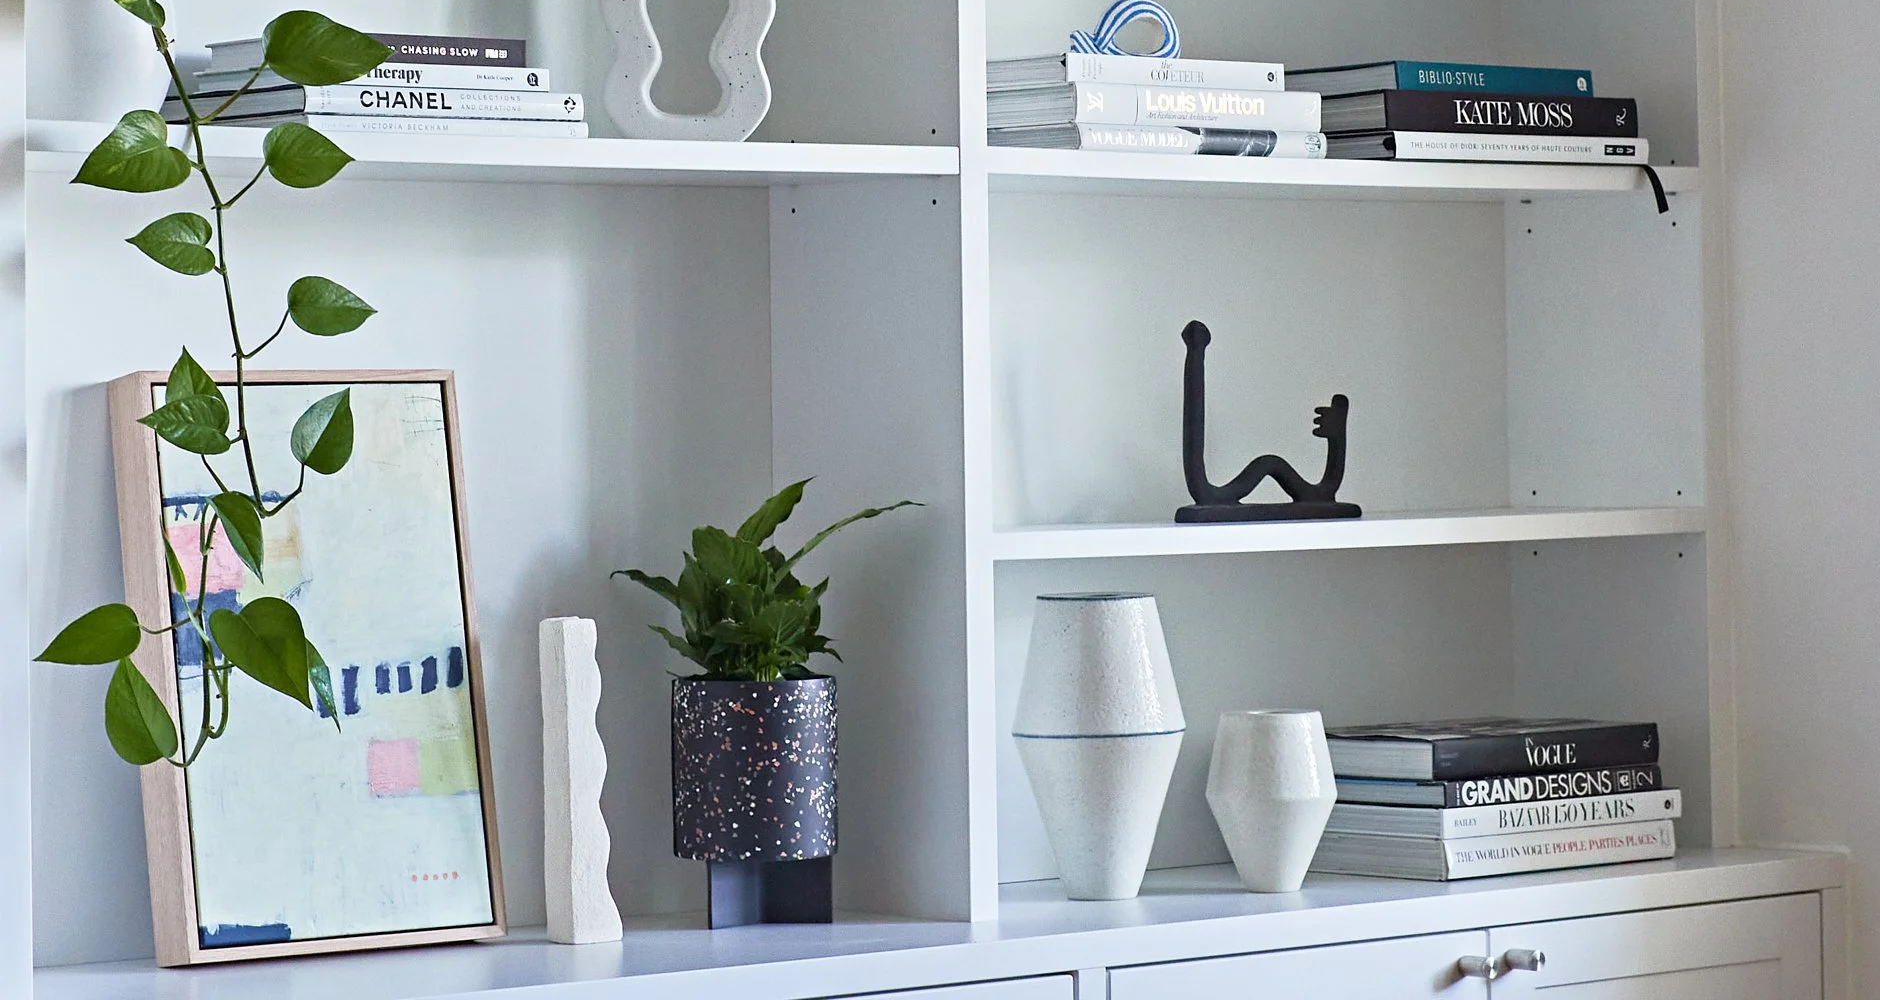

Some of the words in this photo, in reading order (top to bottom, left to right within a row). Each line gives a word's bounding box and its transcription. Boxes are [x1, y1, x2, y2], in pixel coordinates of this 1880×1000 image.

[400, 45, 447, 57] CHASING
[449, 47, 478, 57] SLOW
[1160, 60, 1173, 69] the
[367, 67, 423, 84] herapy
[359, 90, 453, 110] CHANEL
[460, 94, 521, 102] COLLECTIONS
[1145, 88, 1197, 113] Louis
[1199, 92, 1265, 116] Vuitton
[1453, 99, 1512, 126] KATE
[1516, 101, 1573, 129] MOSS
[362, 123, 403, 131] VICTORIA
[1090, 129, 1139, 146] VOGUE
[1140, 132, 1188, 148] MODEL
[1525, 737, 1535, 747] IN
[1526, 743, 1576, 767] VOGUE
[1461, 777, 1534, 806] GRAND
[1536, 770, 1612, 799] DESIGNS
[1454, 817, 1478, 828] BAILEY
[1555, 803, 1578, 825] 150
[1579, 798, 1635, 824] YEARS
[1455, 851, 1474, 864] THE
[1474, 848, 1509, 862] WORLD
[1510, 846, 1522, 859] IN
[1522, 843, 1551, 857] VOGUE
[1552, 839, 1587, 854] PEOPLE
[1589, 836, 1625, 851] PARTIES
[1625, 834, 1657, 847] PLACES
